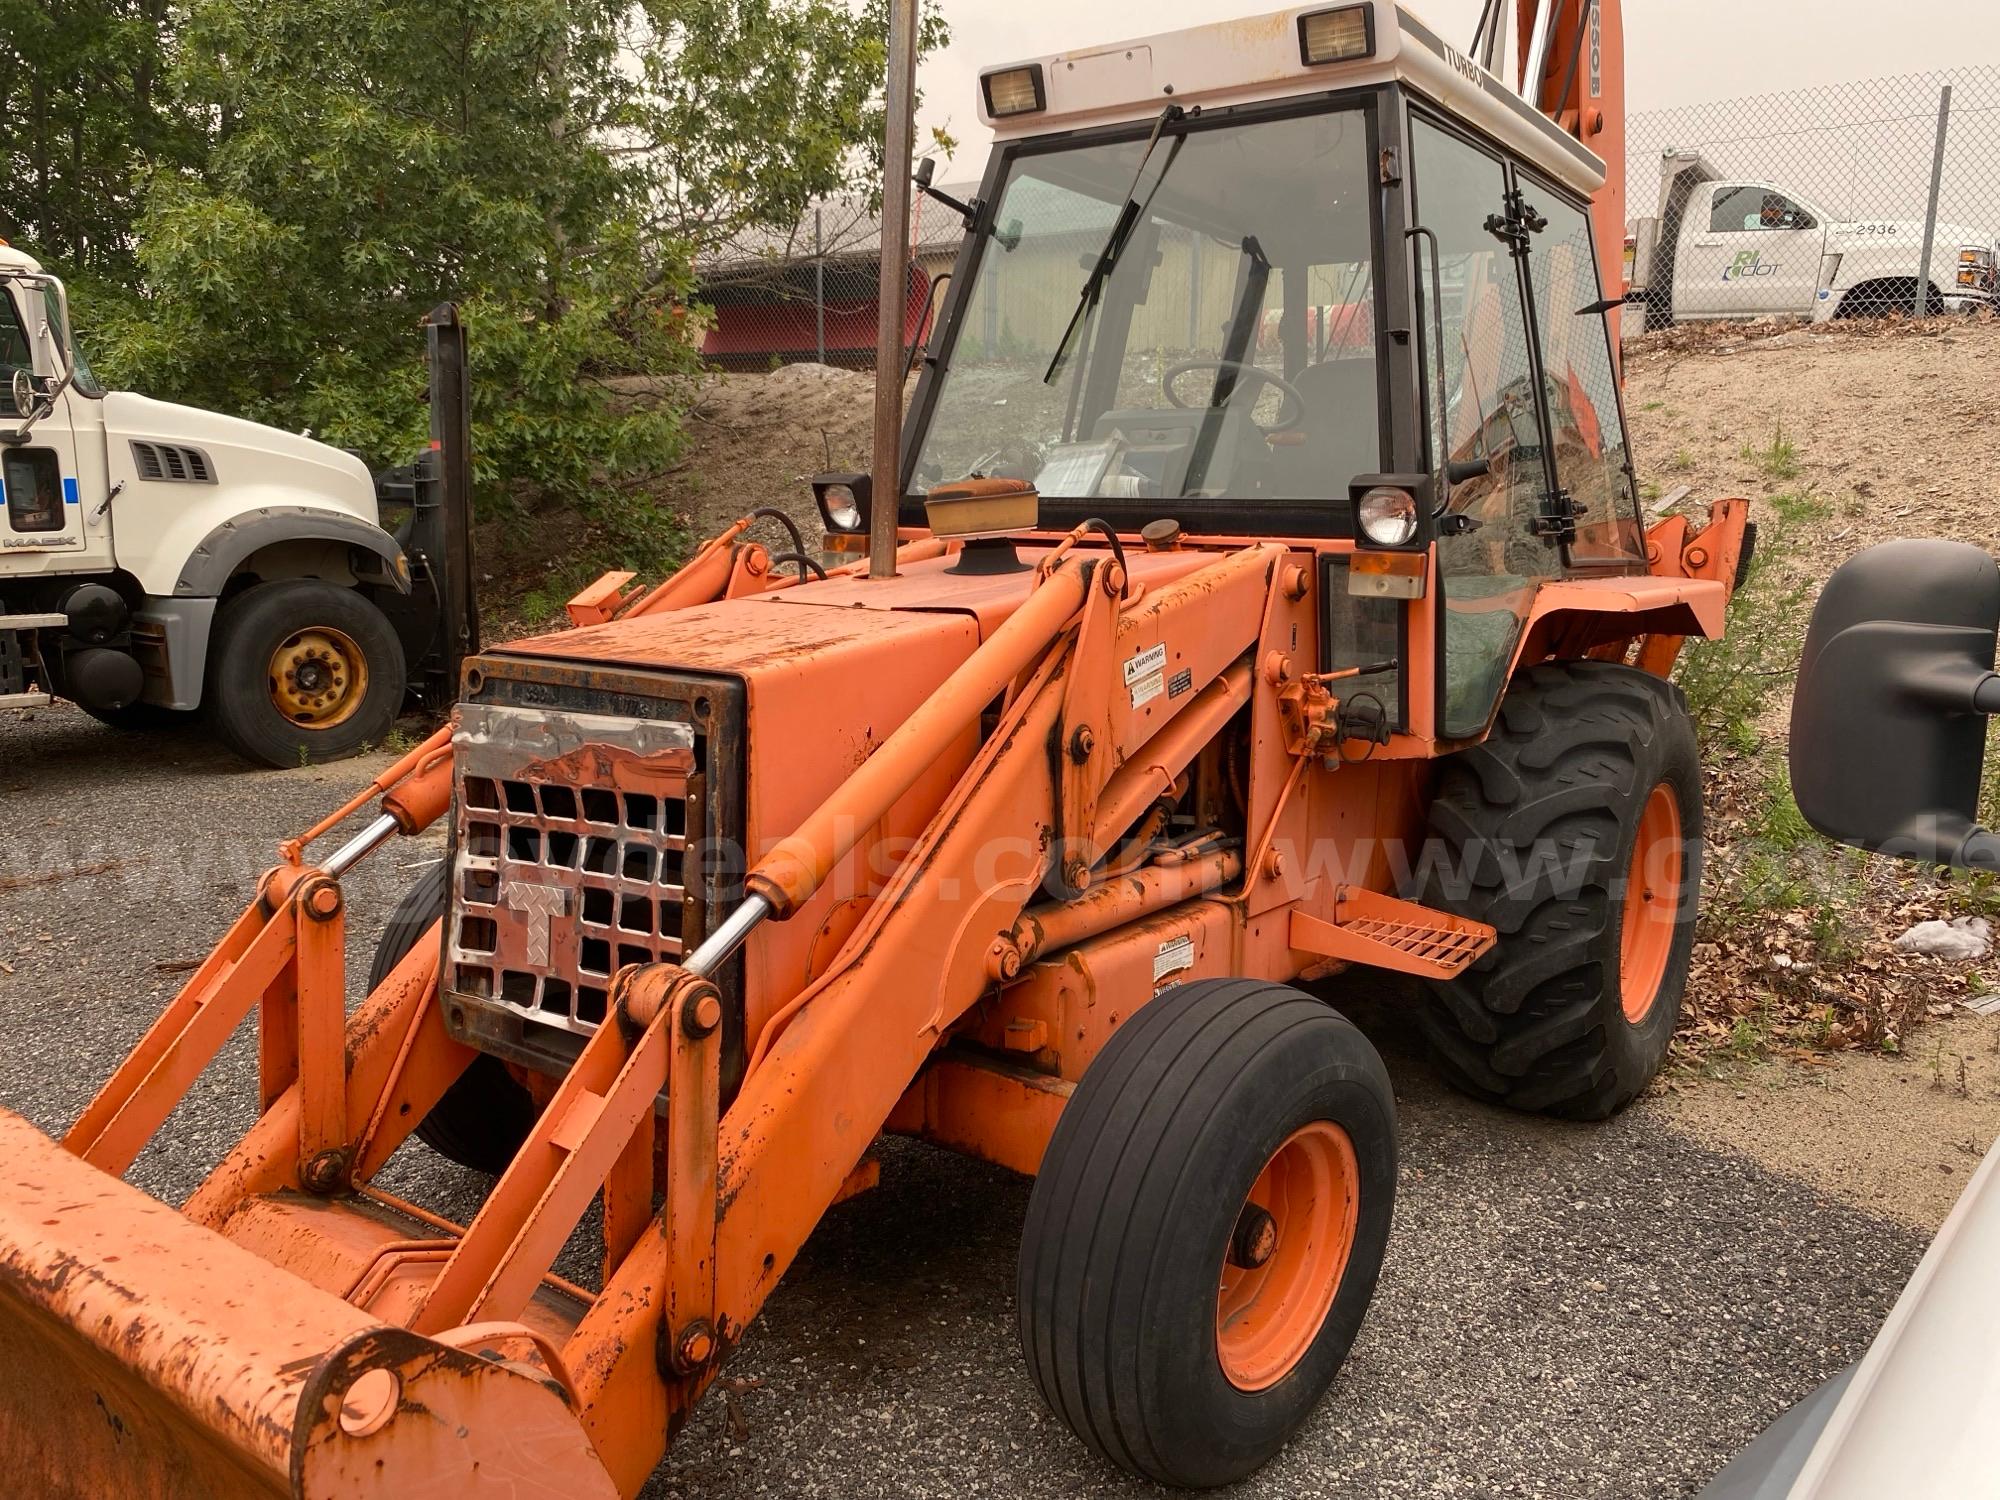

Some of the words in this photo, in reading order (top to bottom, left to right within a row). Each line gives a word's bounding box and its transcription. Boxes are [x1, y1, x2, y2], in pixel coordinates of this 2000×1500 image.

[1444, 42, 1482, 88] TURBO
[1856, 224, 1896, 235] 2936
[1733, 250, 1760, 266] RI
[4, 536, 77, 548] MACK
[1134, 647, 1164, 670] WARNING
